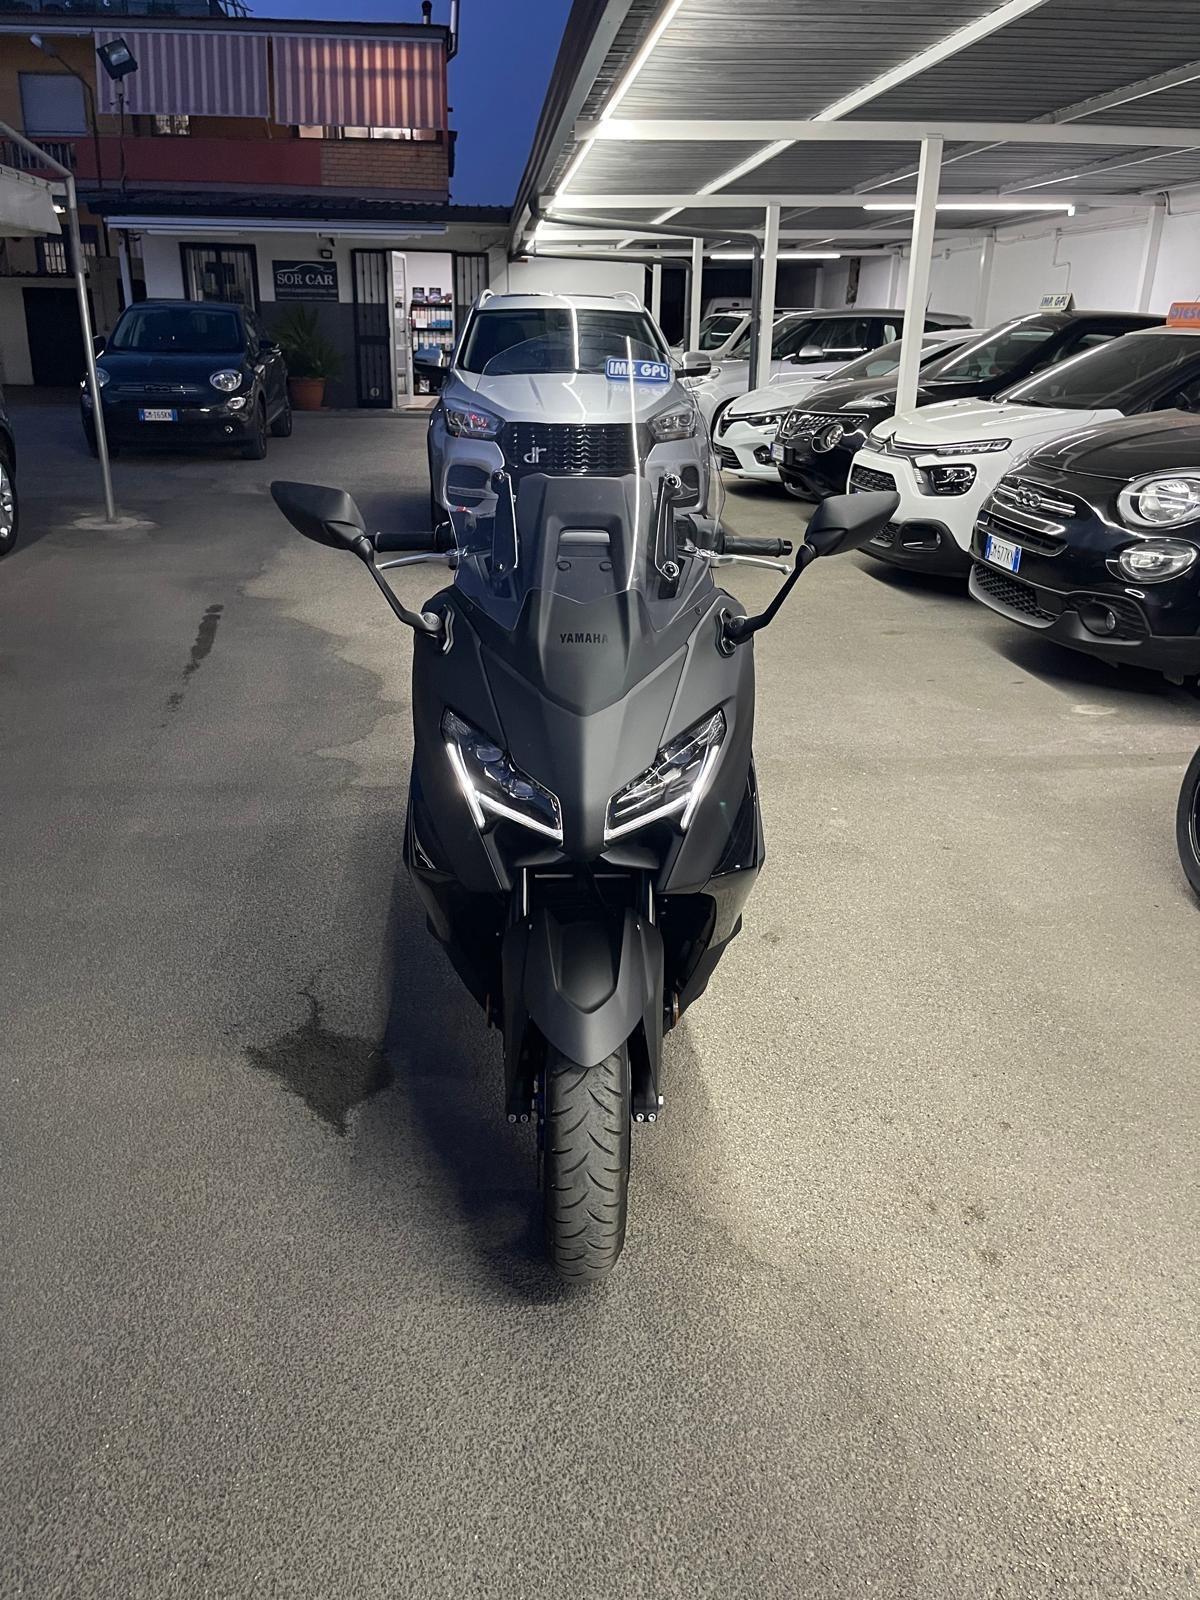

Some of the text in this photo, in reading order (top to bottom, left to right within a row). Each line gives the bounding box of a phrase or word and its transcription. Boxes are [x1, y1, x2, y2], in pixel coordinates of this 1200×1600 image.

[277, 273, 334, 286] SOR CAR
[640, 363, 667, 378] GPL
[523, 446, 547, 464] dr
[560, 632, 609, 644] YAMAHA
